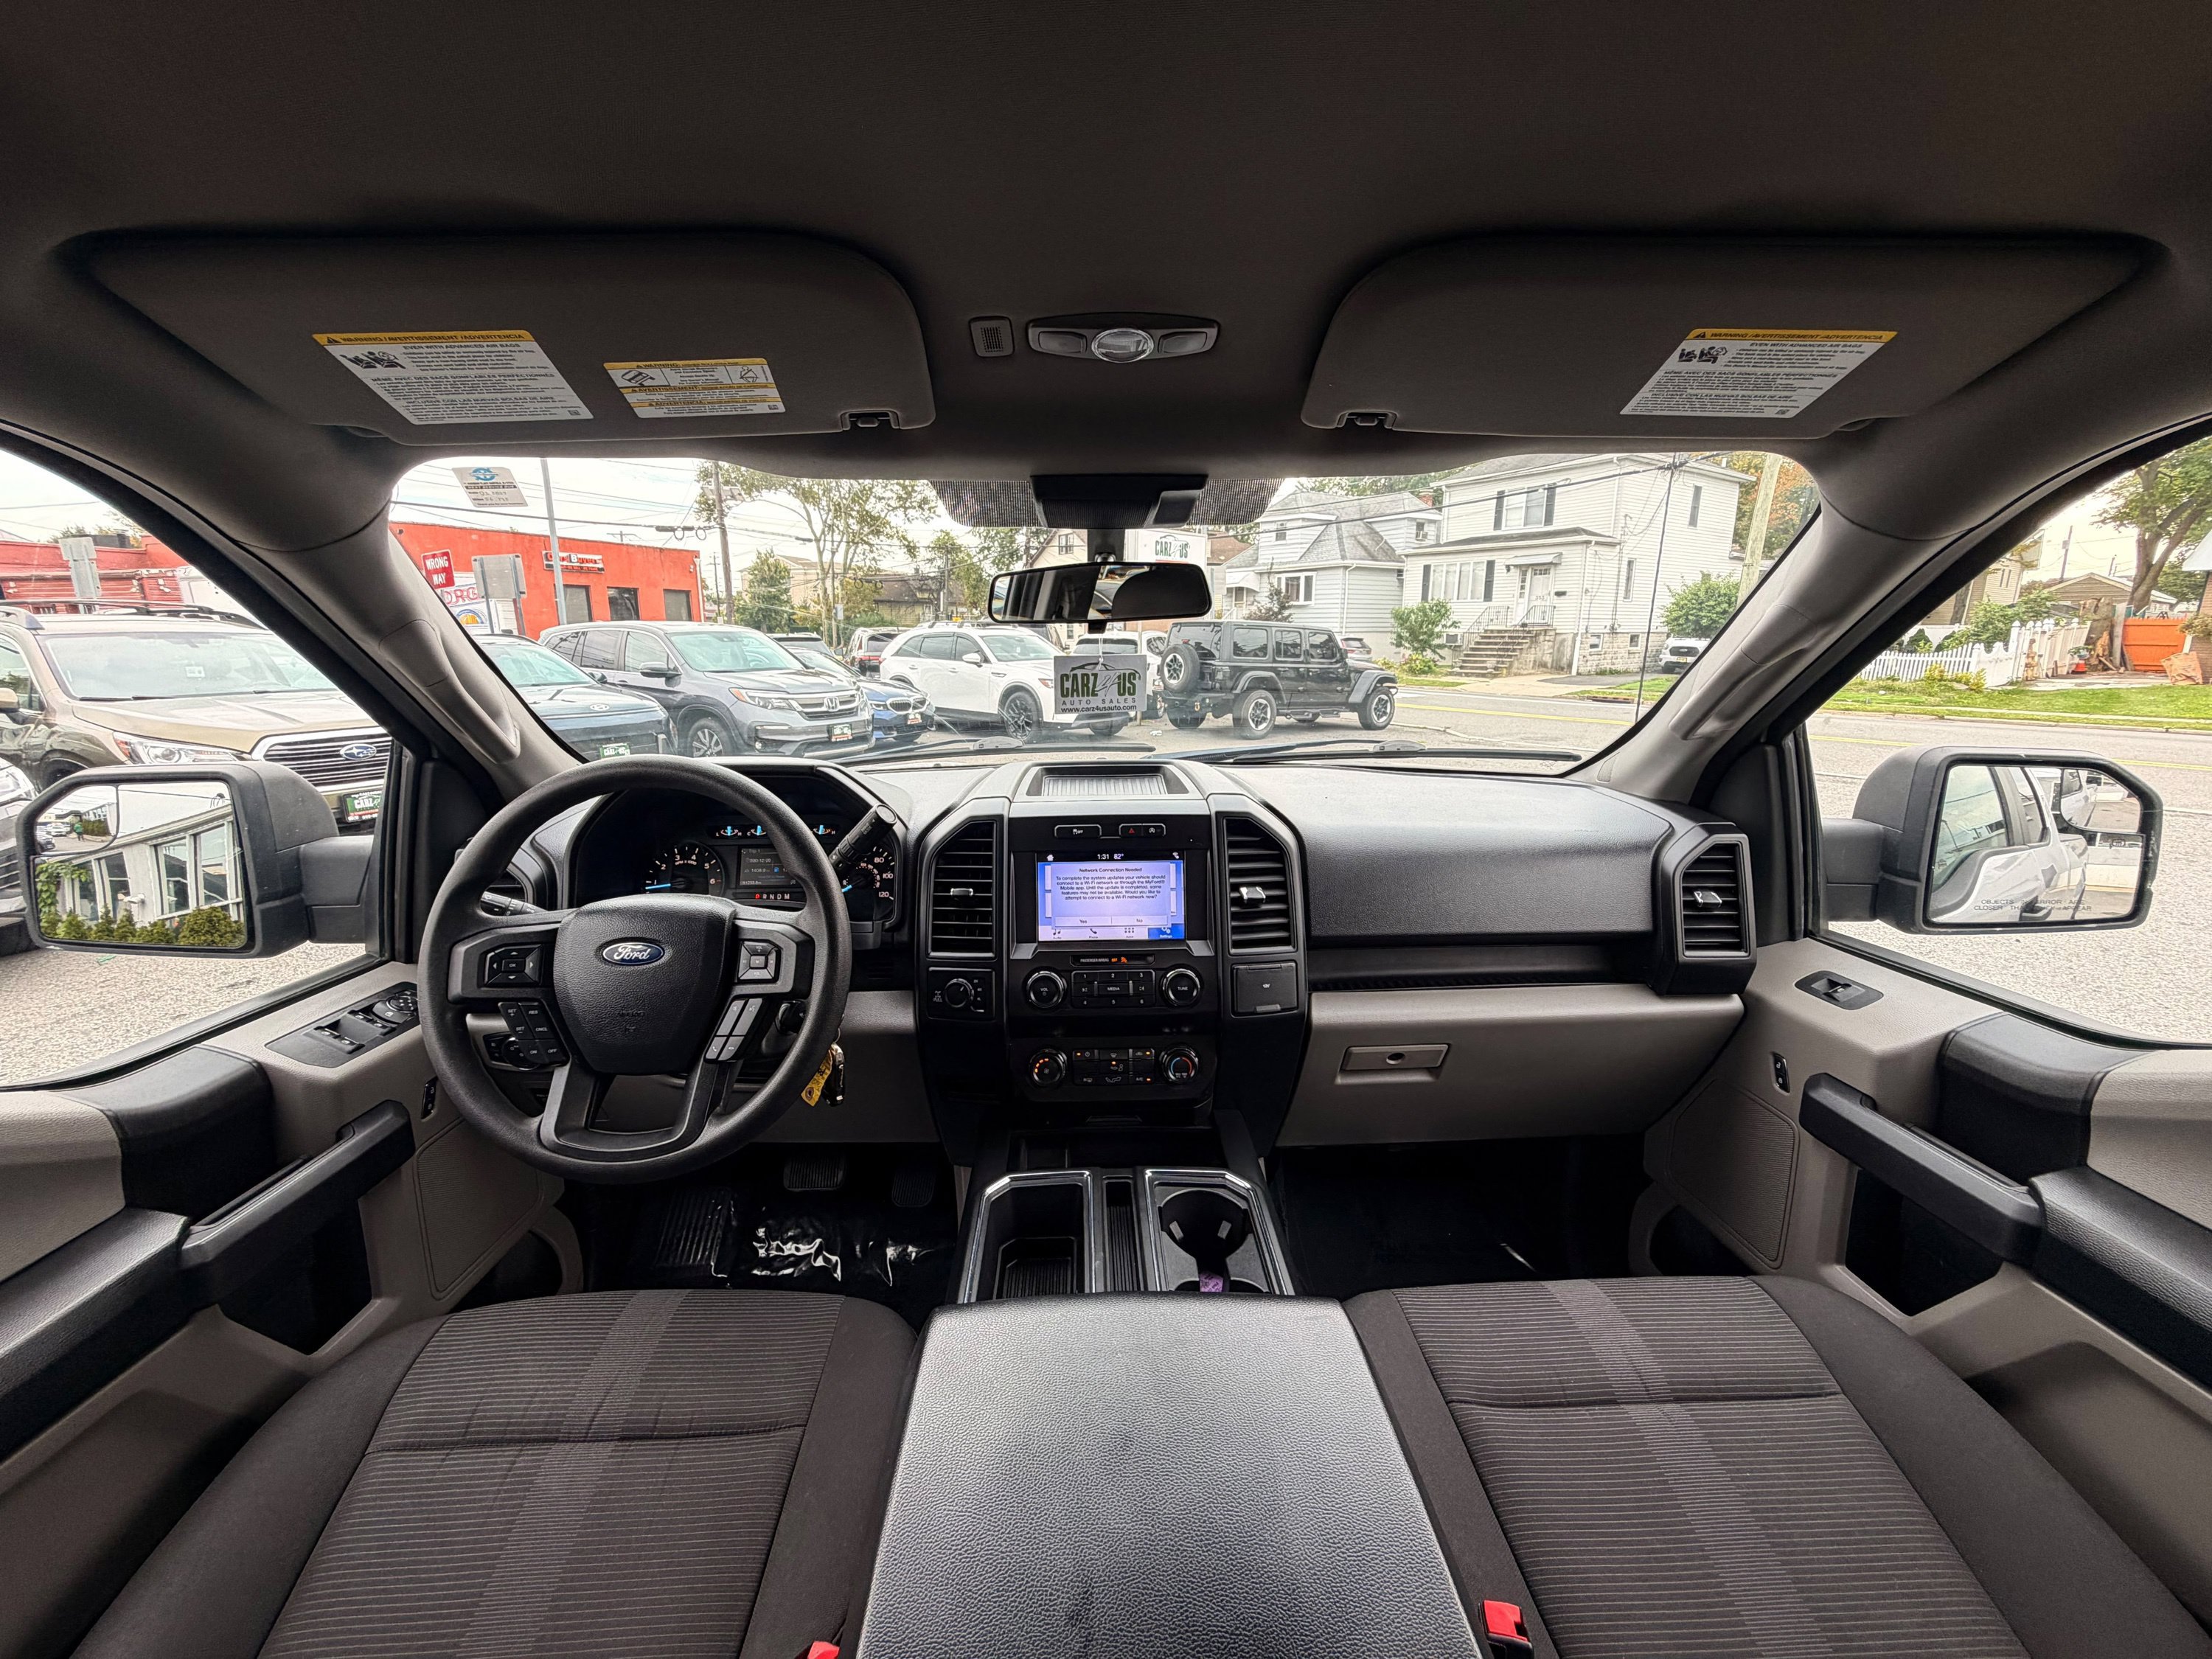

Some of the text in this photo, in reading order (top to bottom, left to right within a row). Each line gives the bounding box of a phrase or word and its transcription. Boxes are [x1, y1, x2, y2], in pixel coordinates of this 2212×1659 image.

[425, 556, 448, 571] WRONG
[432, 572, 447, 585] WAY
[1061, 704, 1137, 713] www.carz4usauto.com
[613, 945, 651, 960] Ford
